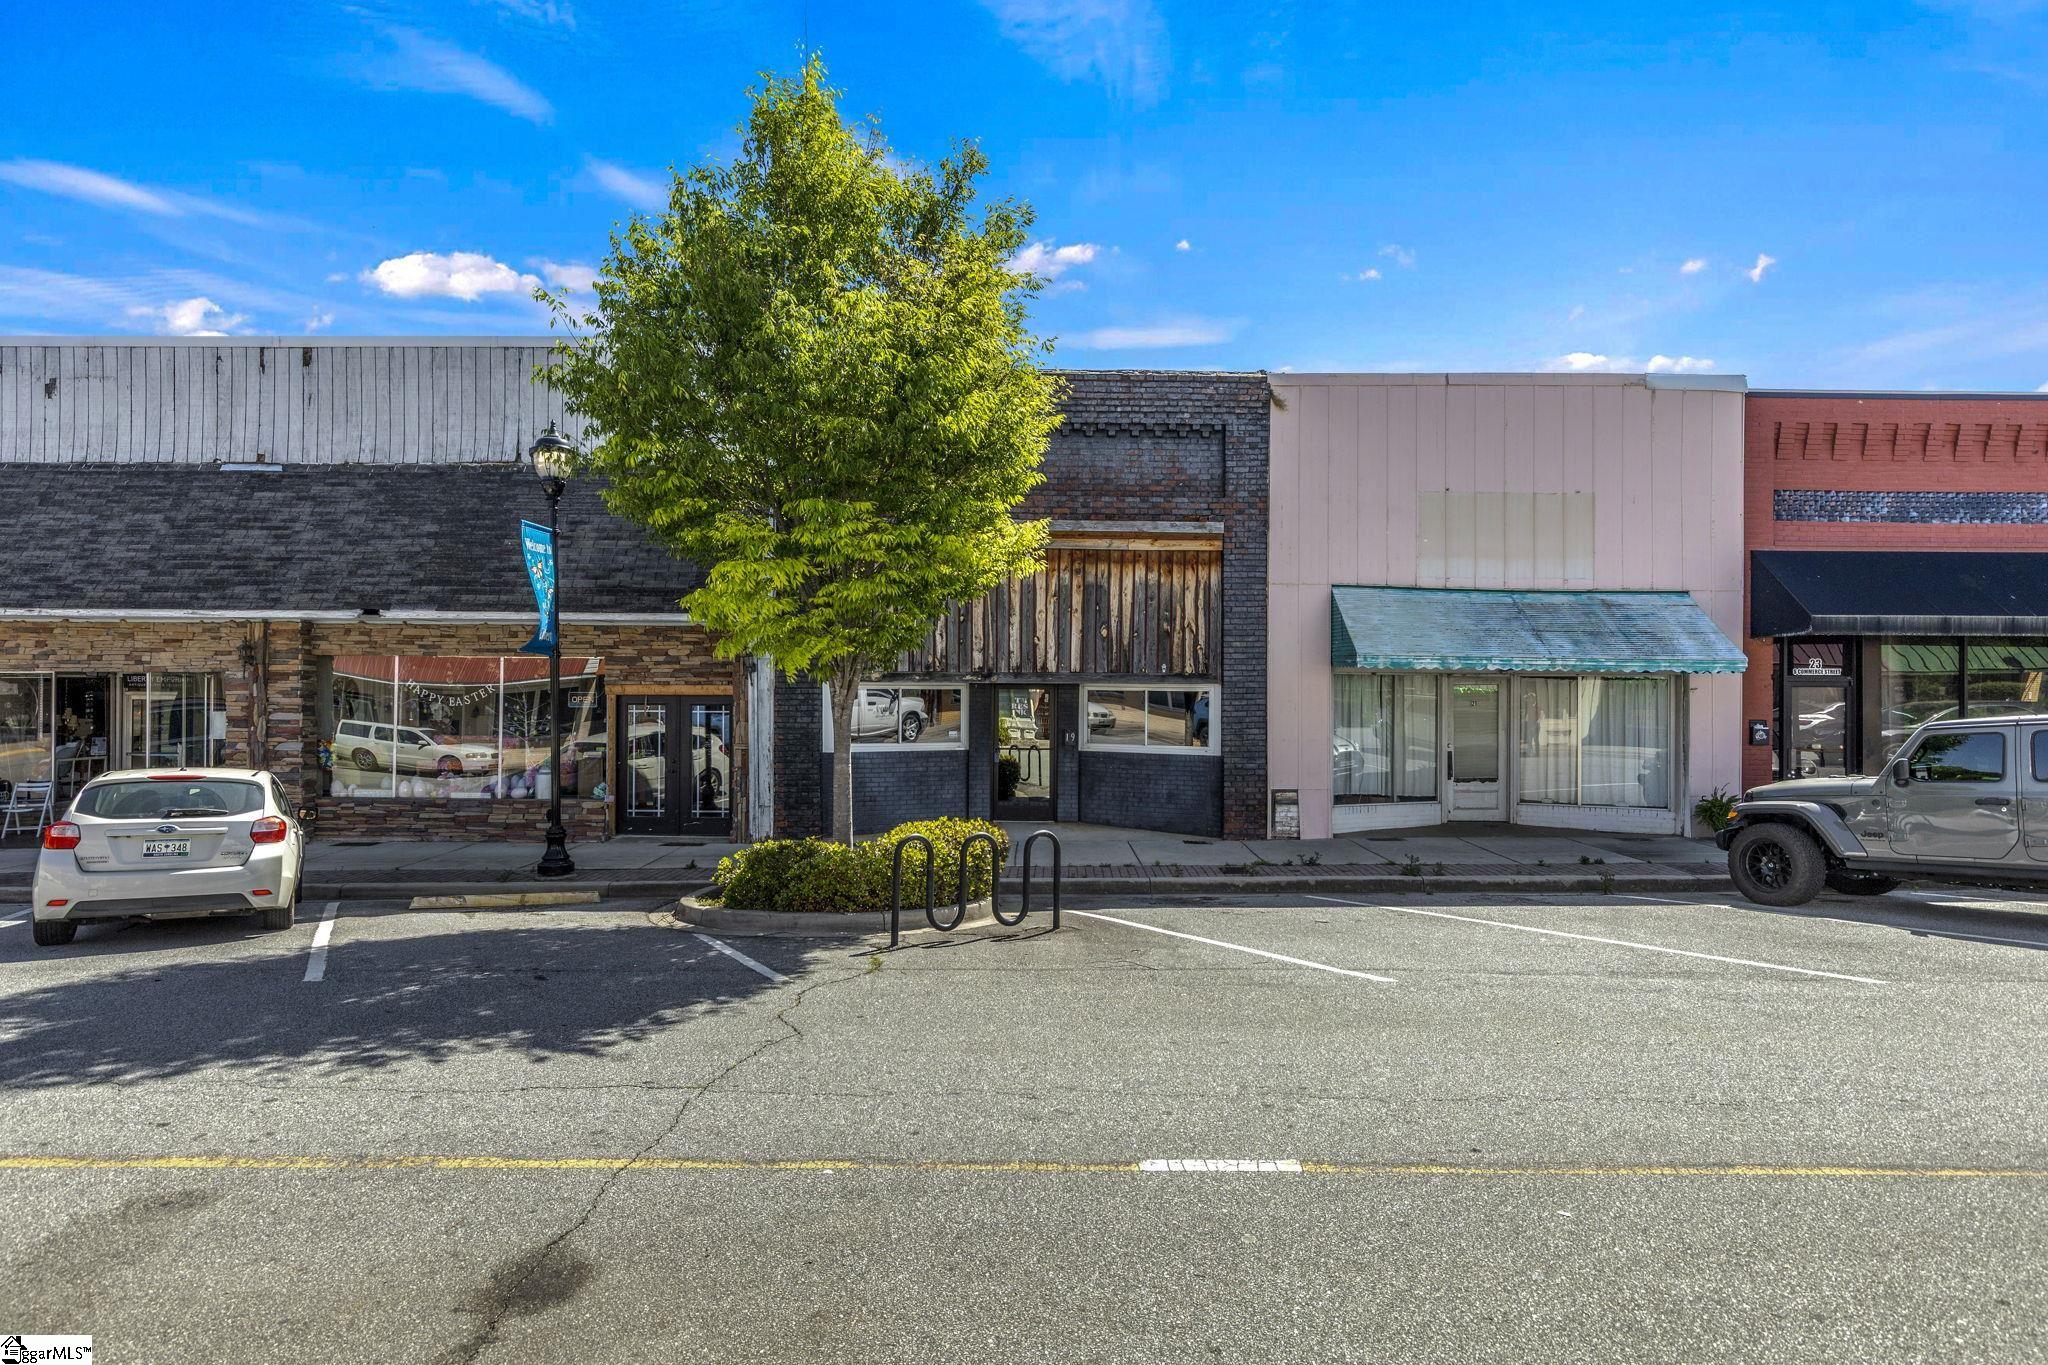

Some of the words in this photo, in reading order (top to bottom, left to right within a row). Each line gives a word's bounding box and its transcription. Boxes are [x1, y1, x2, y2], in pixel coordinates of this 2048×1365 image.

[1809, 658, 1822, 669] 23
[406, 678, 444, 704] HAPPY
[449, 684, 495, 706] EASTER
[1066, 732, 1075, 741] 19
[1860, 830, 1883, 839] Jeep
[146, 844, 163, 853] WAS
[170, 843, 188, 852] 348
